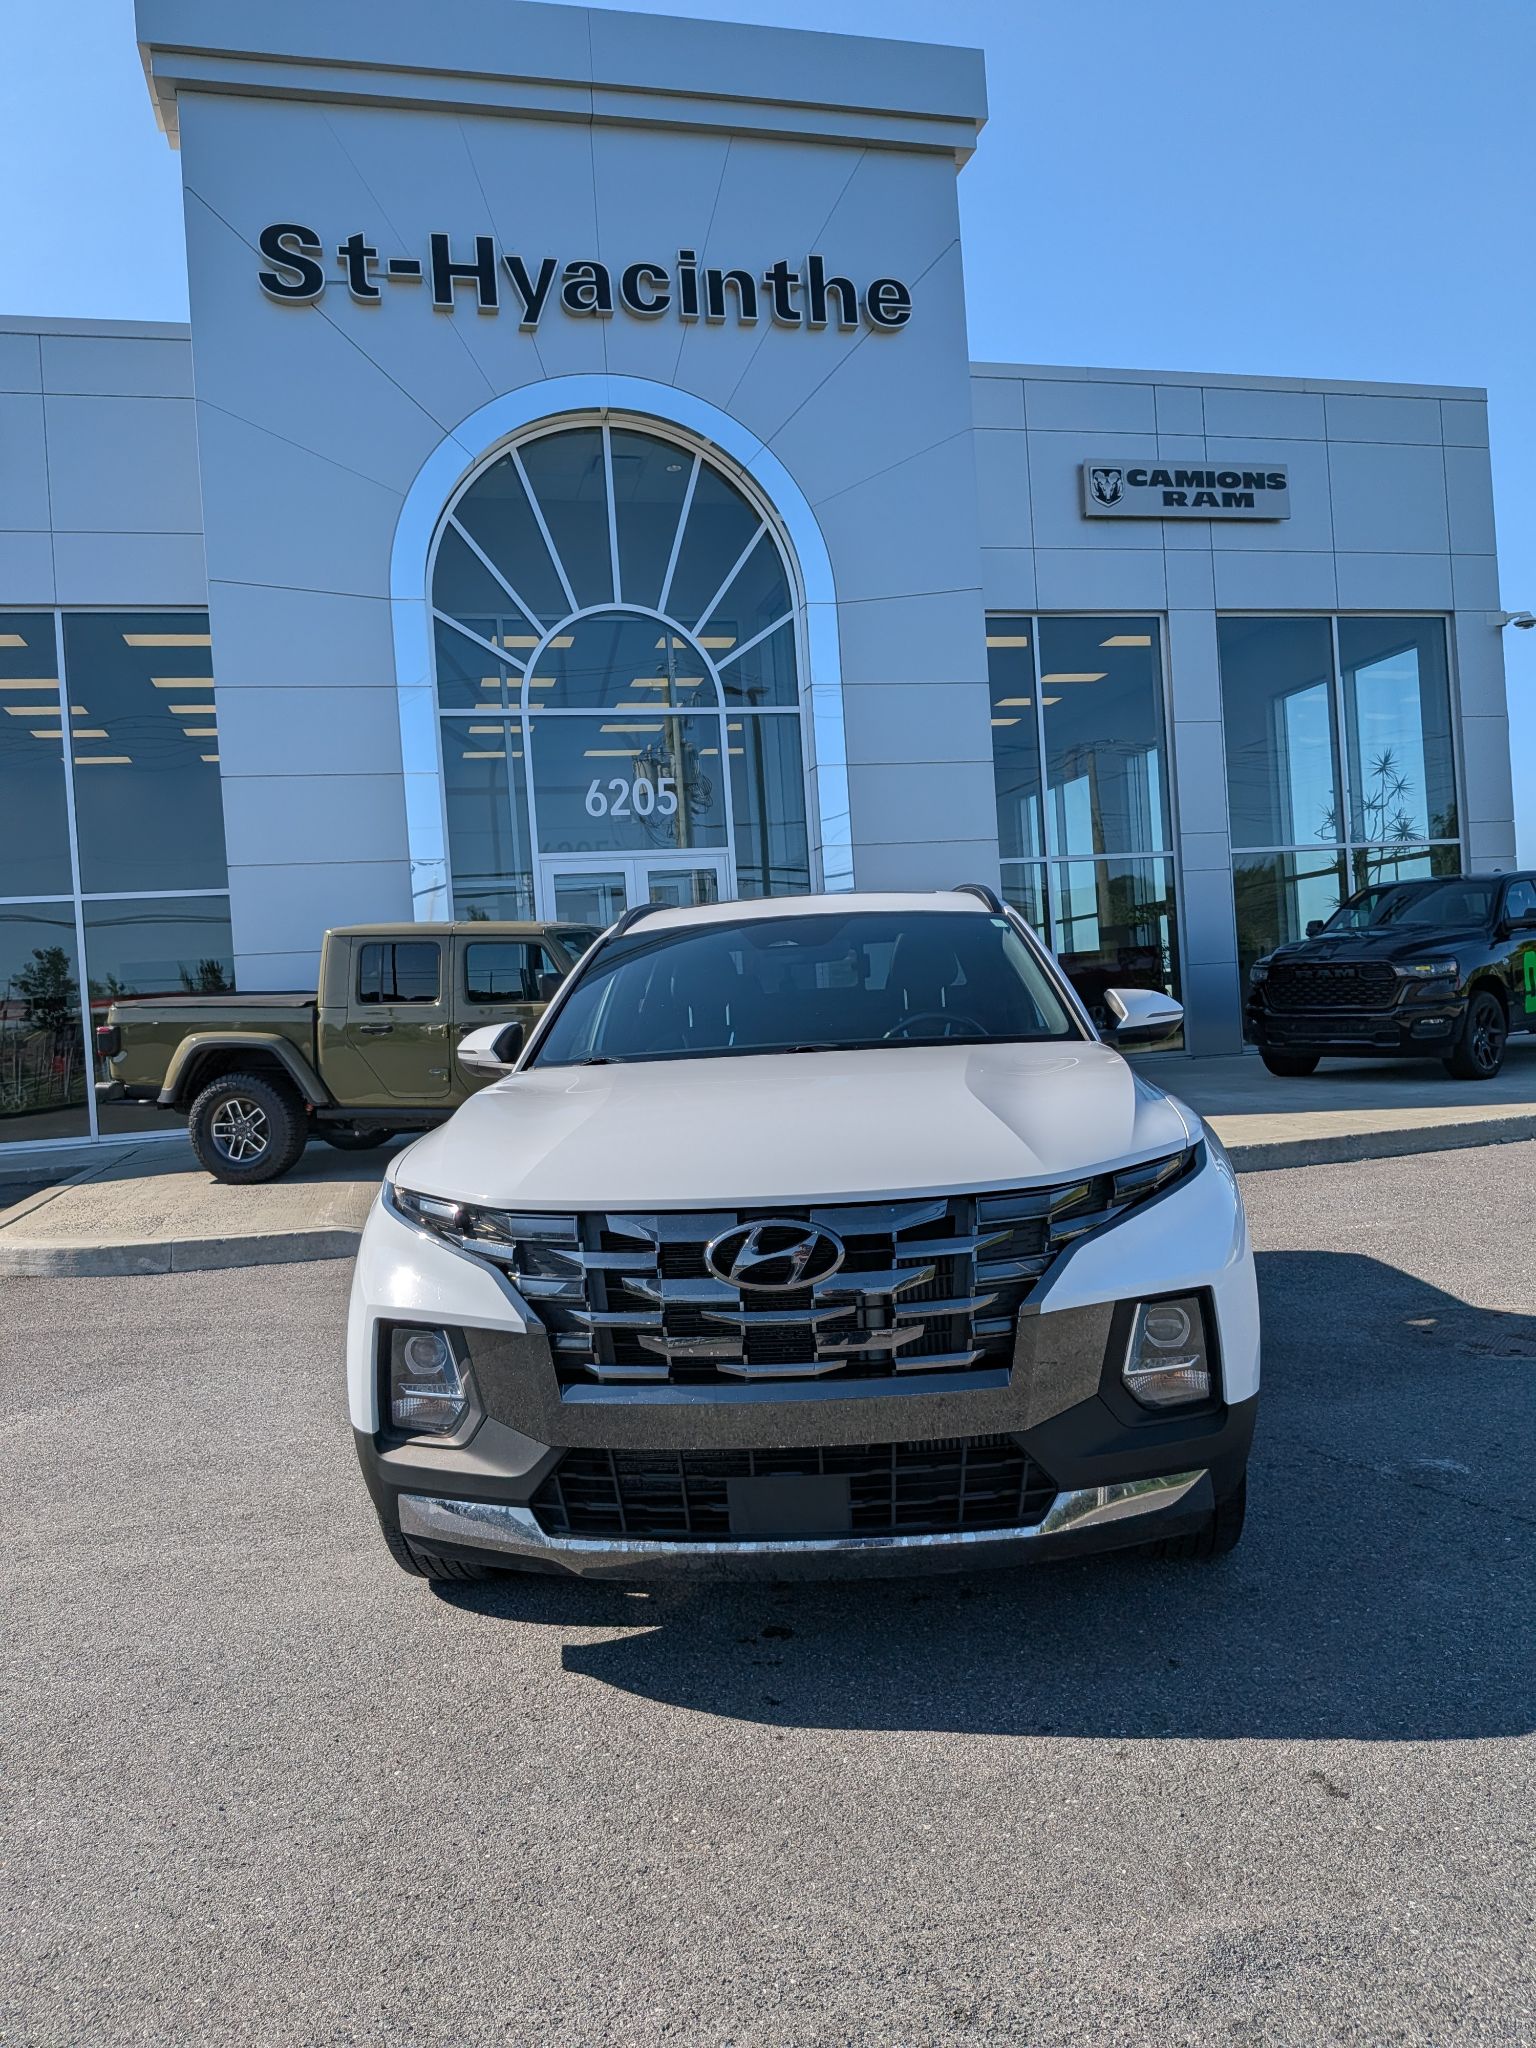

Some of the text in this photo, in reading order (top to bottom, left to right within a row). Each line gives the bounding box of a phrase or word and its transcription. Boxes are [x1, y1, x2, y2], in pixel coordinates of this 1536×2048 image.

[258, 222, 912, 331] St-Hyacinthe
[1126, 469, 1287, 490] CAMIONS
[1162, 490, 1255, 508] RAM
[585, 777, 678, 817] 6205
[1295, 968, 1356, 980] RAM
